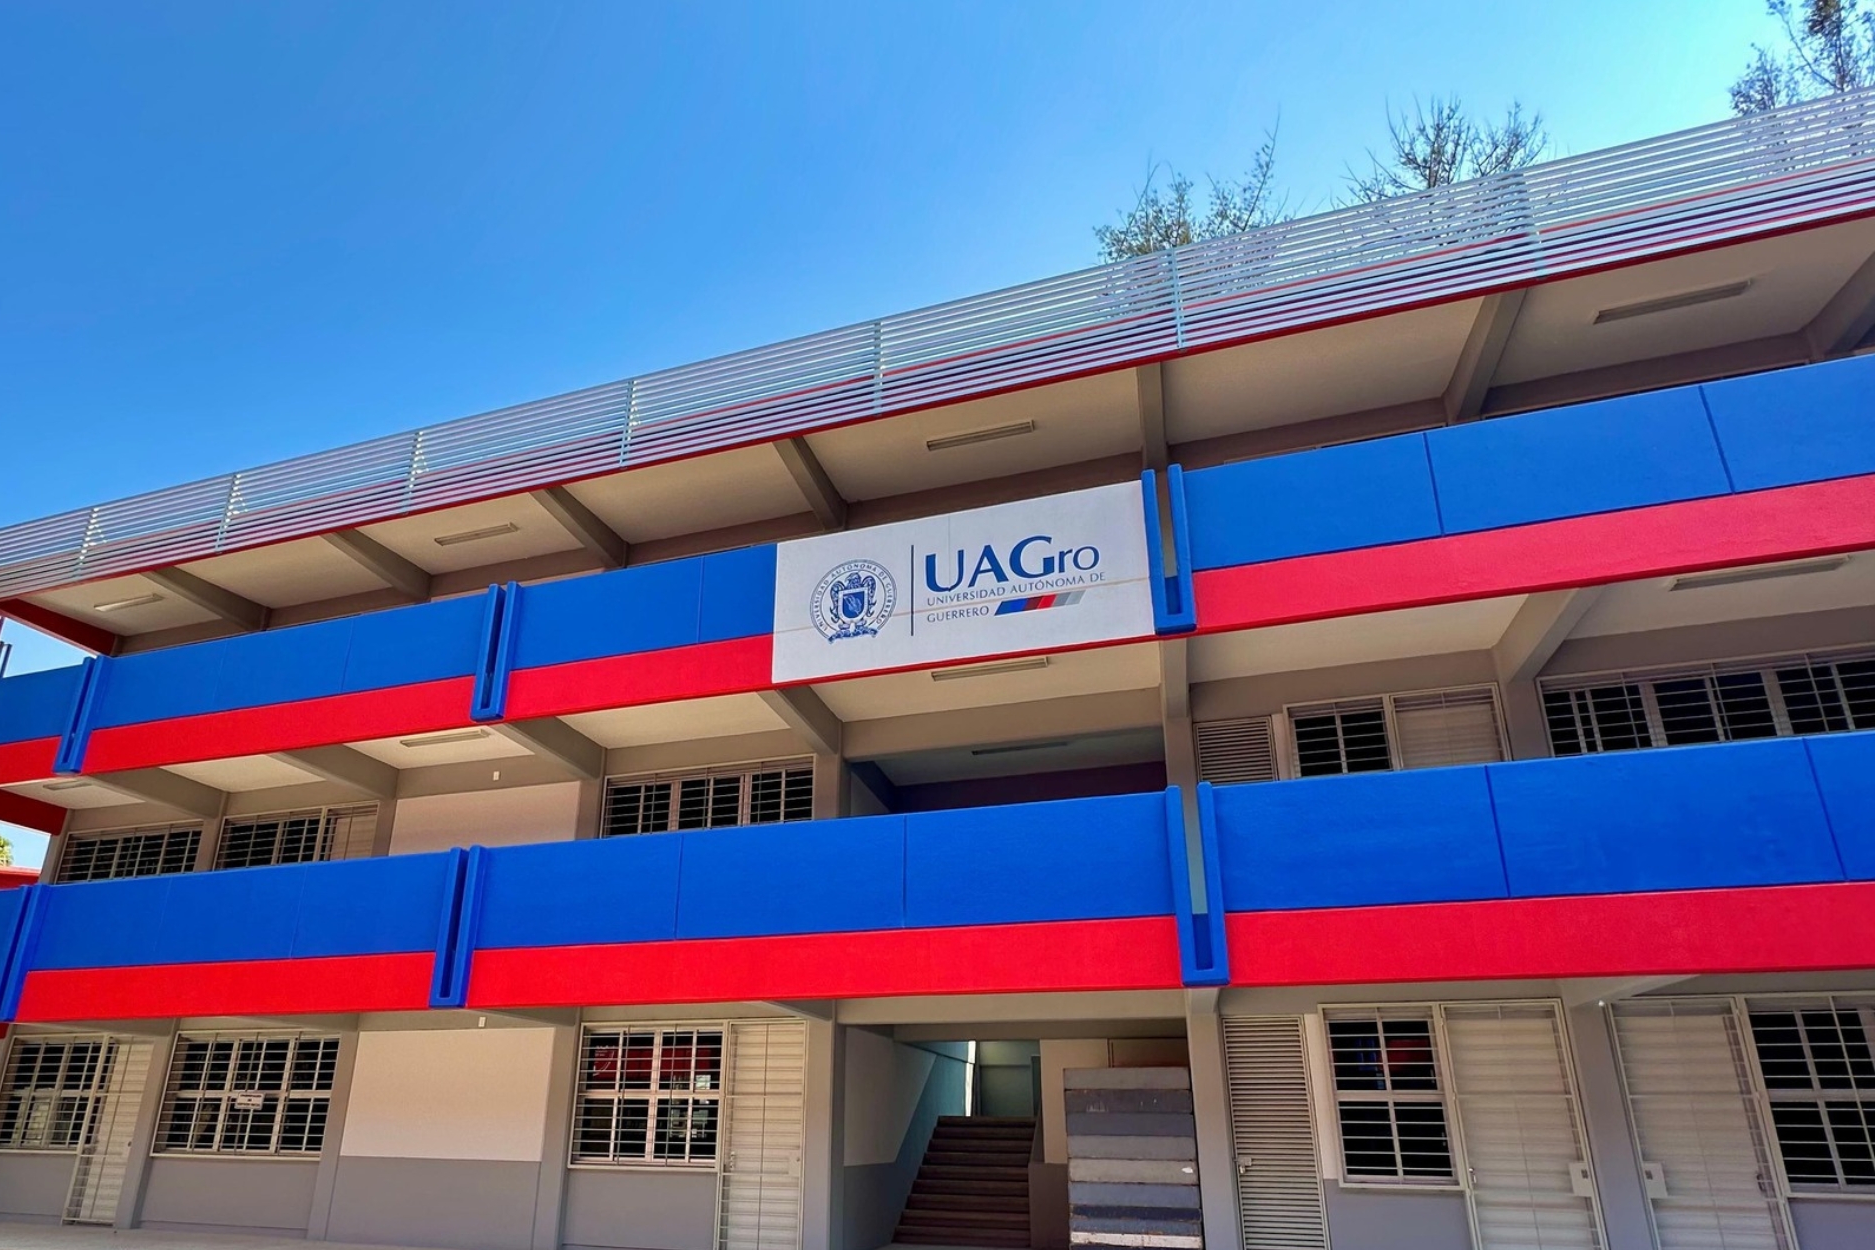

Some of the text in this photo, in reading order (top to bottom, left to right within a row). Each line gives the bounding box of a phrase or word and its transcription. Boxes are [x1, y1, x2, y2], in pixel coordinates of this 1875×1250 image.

[925, 535, 1100, 593] UAGro
[927, 571, 1106, 606] UNIVERSIDAD AUTÓNOMA DE
[927, 606, 990, 623] GUERRERO
